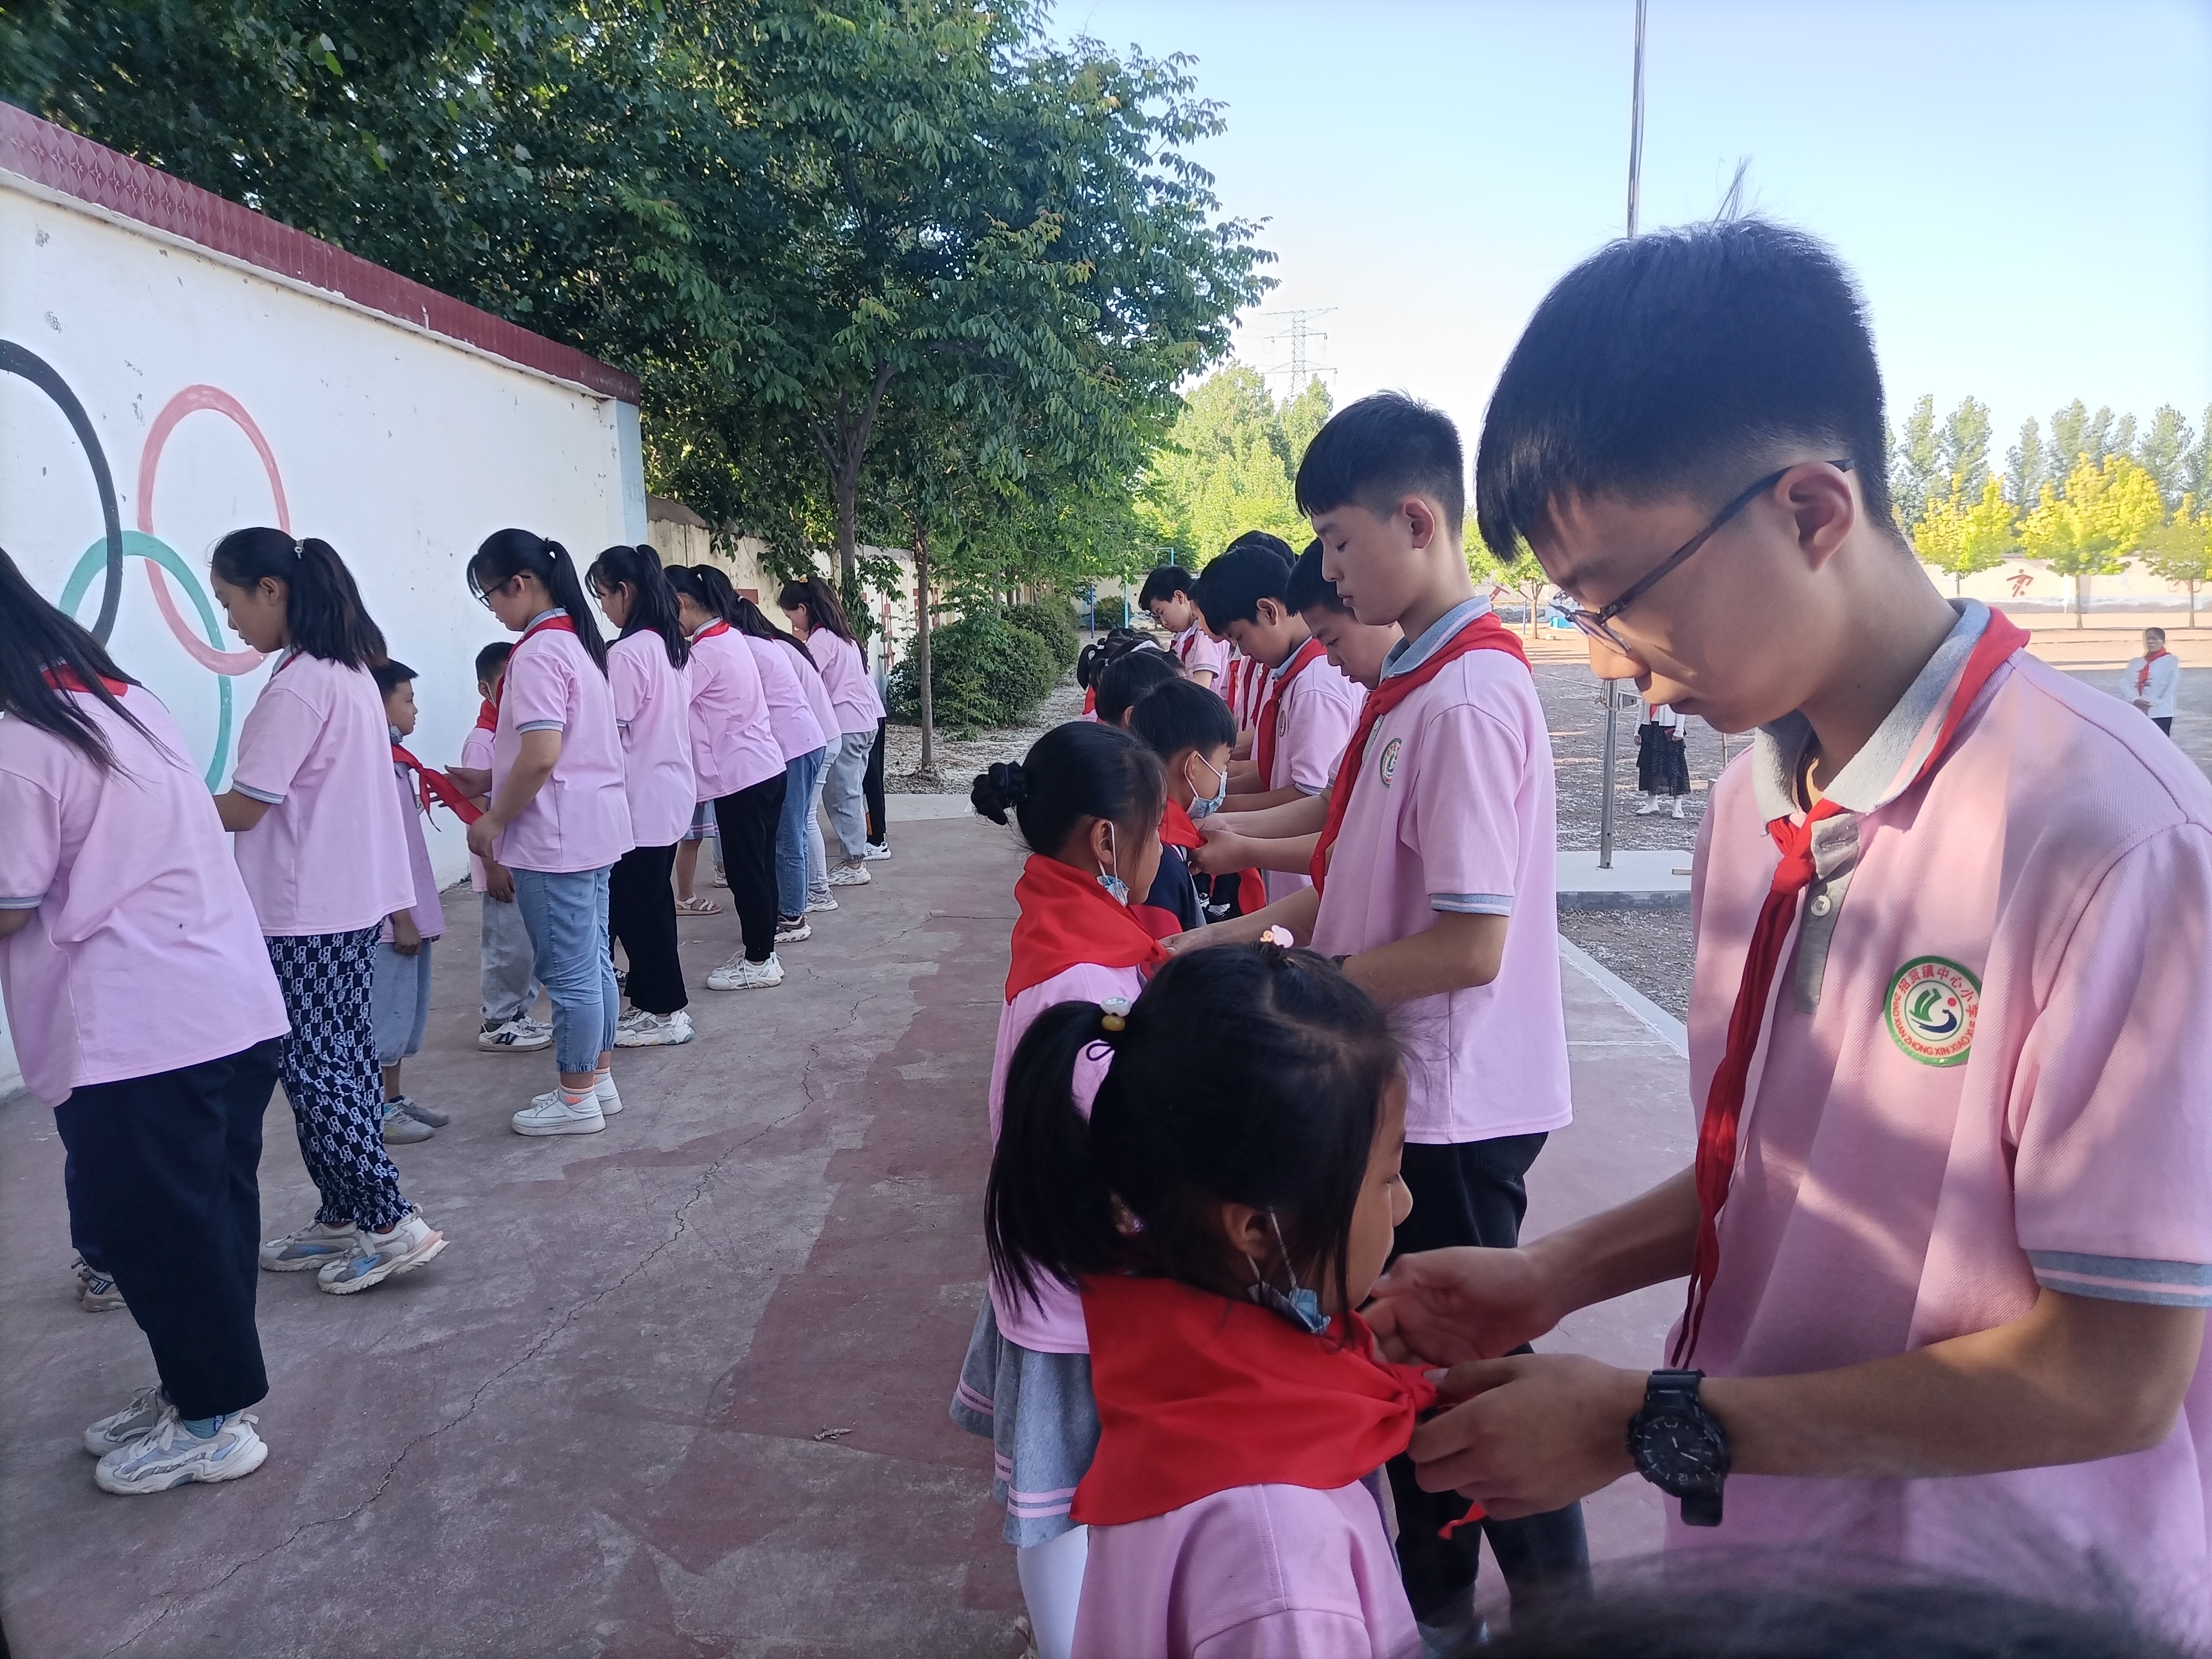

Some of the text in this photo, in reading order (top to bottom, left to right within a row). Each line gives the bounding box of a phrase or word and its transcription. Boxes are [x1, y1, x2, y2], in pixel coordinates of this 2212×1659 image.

[1894, 1016, 1906, 1038] XIAN
[1904, 1036, 1933, 1055] ZHONG
[1935, 1047, 1950, 1056] XIN
[1949, 1036, 1970, 1051] XIAO
